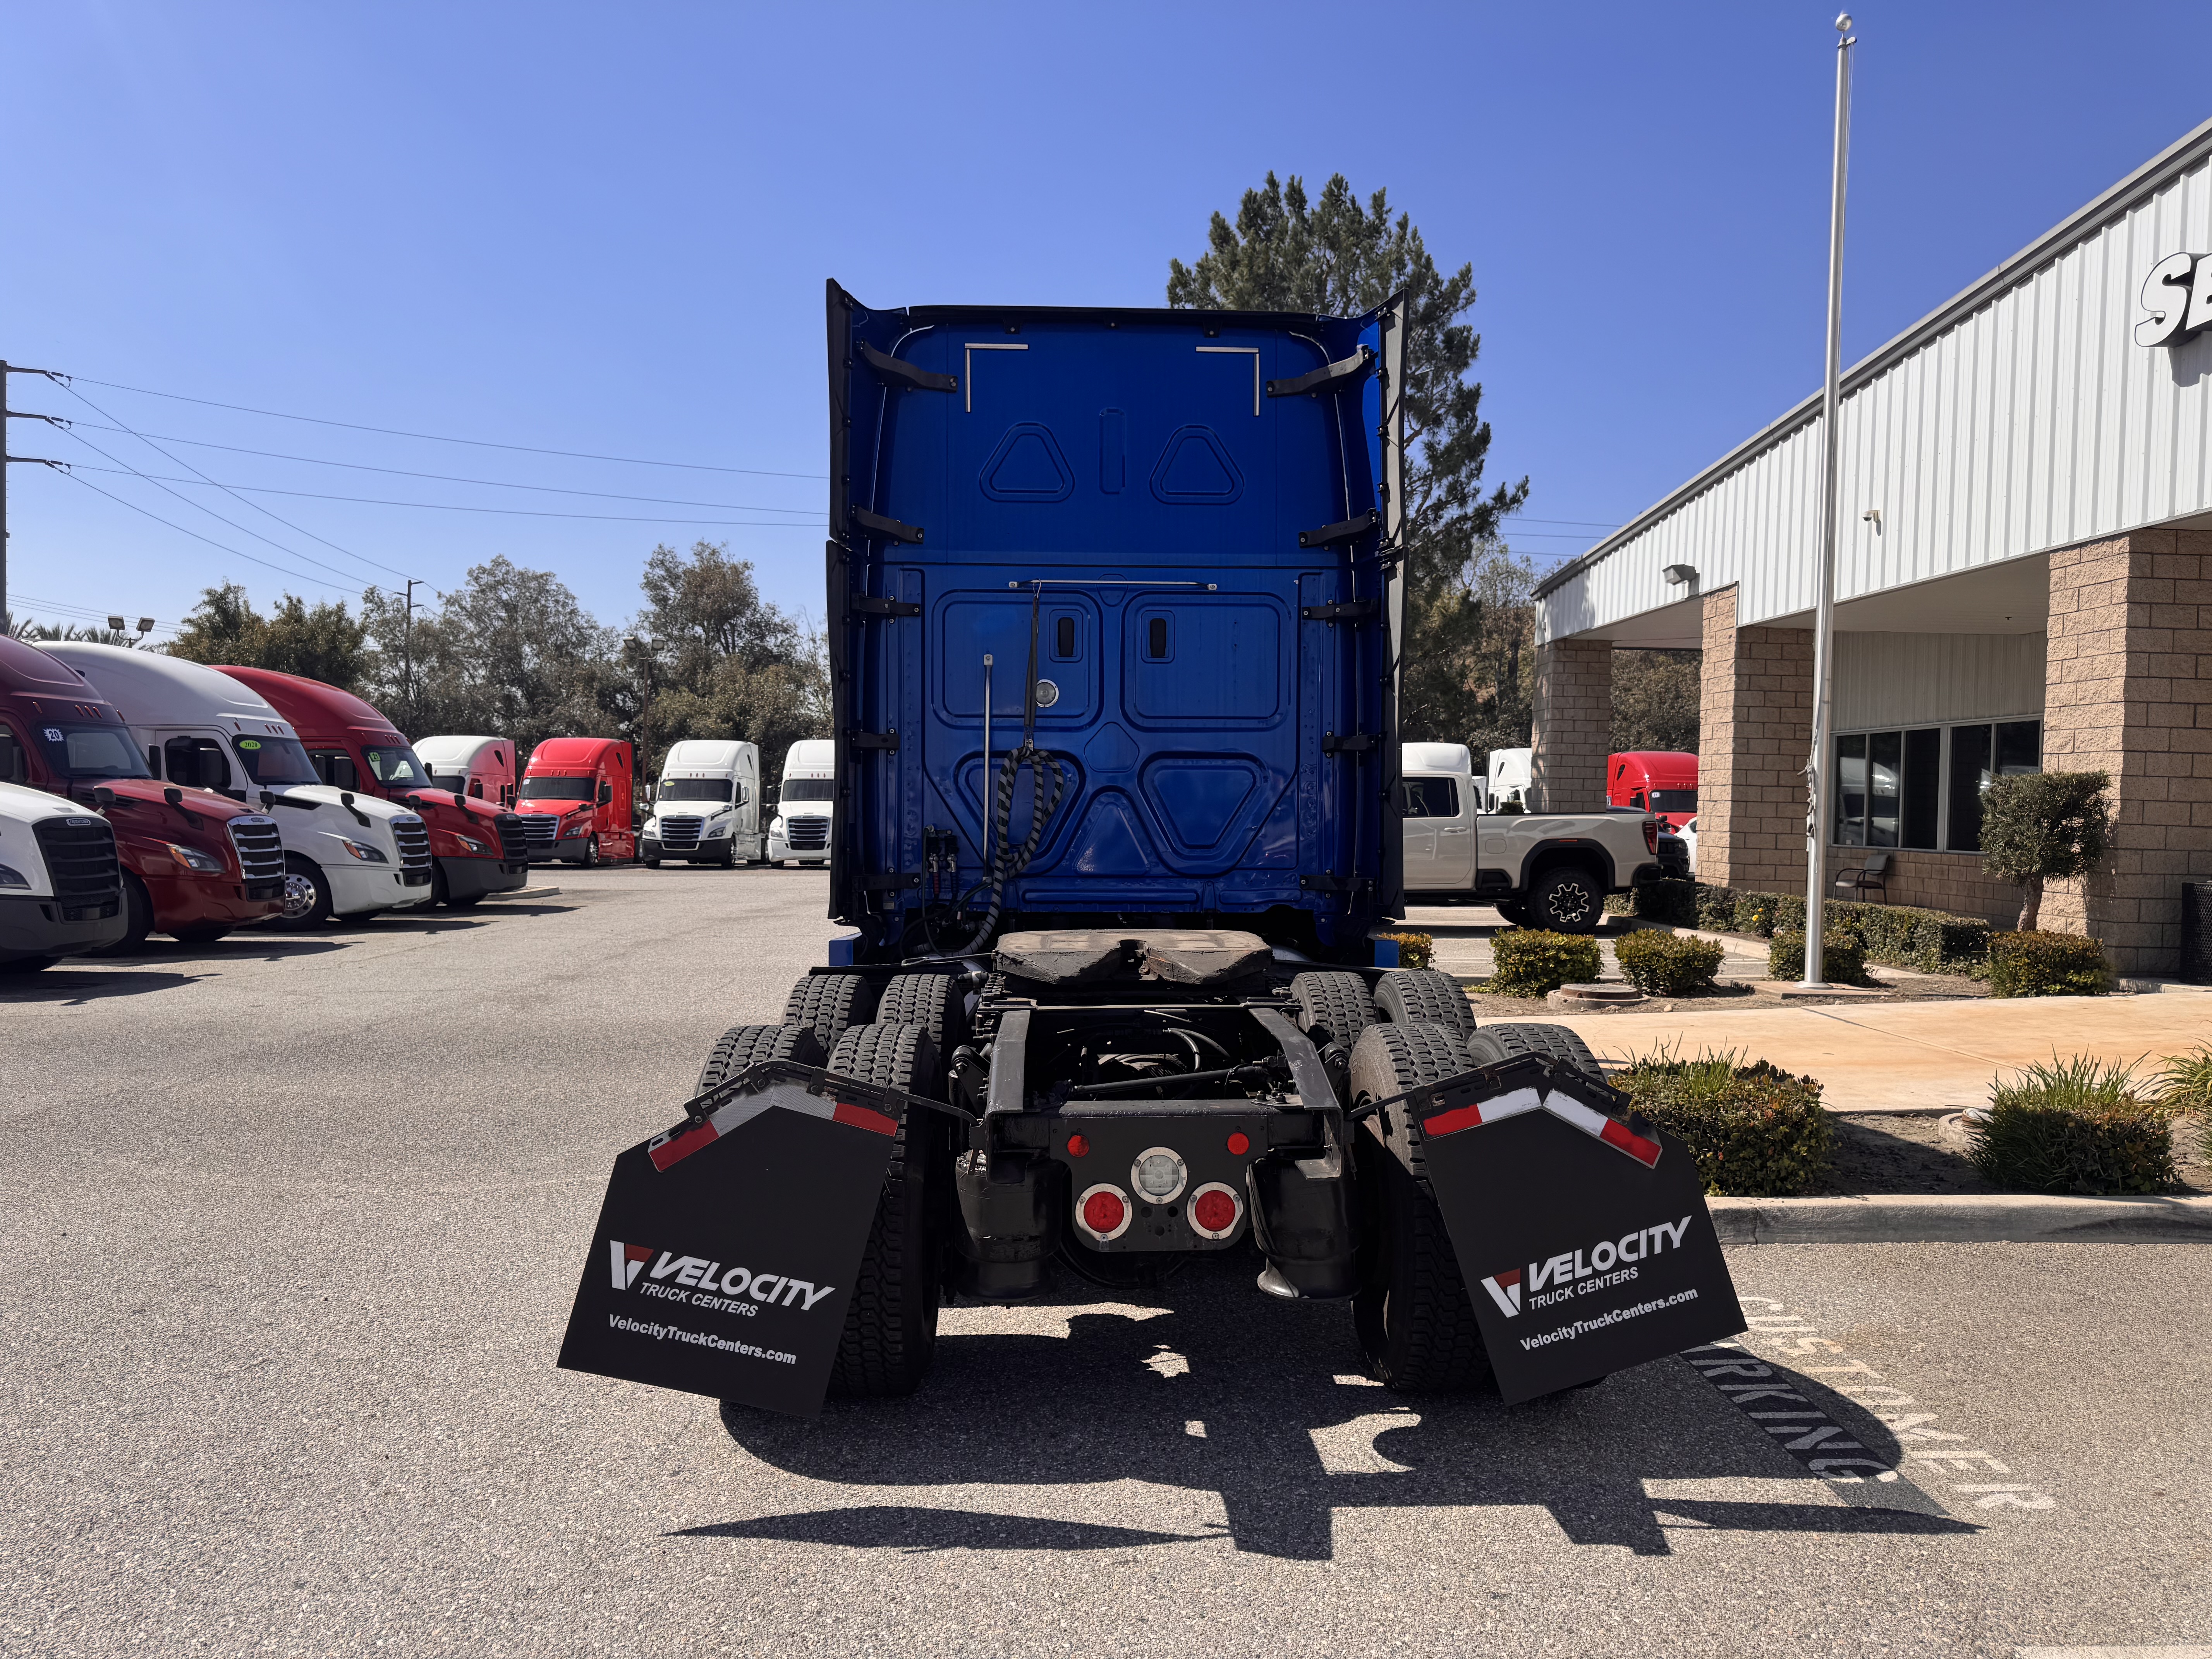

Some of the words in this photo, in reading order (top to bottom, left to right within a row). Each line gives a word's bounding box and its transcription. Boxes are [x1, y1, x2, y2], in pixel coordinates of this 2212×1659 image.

[49, 730, 60, 739] 20
[1529, 1215, 1692, 1292] VELOCITY
[640, 1282, 691, 1303] TRUCK
[692, 1293, 758, 1317] CENTERS
[649, 1251, 836, 1311] VELOCITY
[1529, 1286, 1574, 1310] TRUCK
[1577, 1267, 1638, 1295] CENTERS
[610, 1314, 796, 1365] VelocityTruckCenters.com
[1520, 1288, 1698, 1350] VelocityTruckCenters.com
